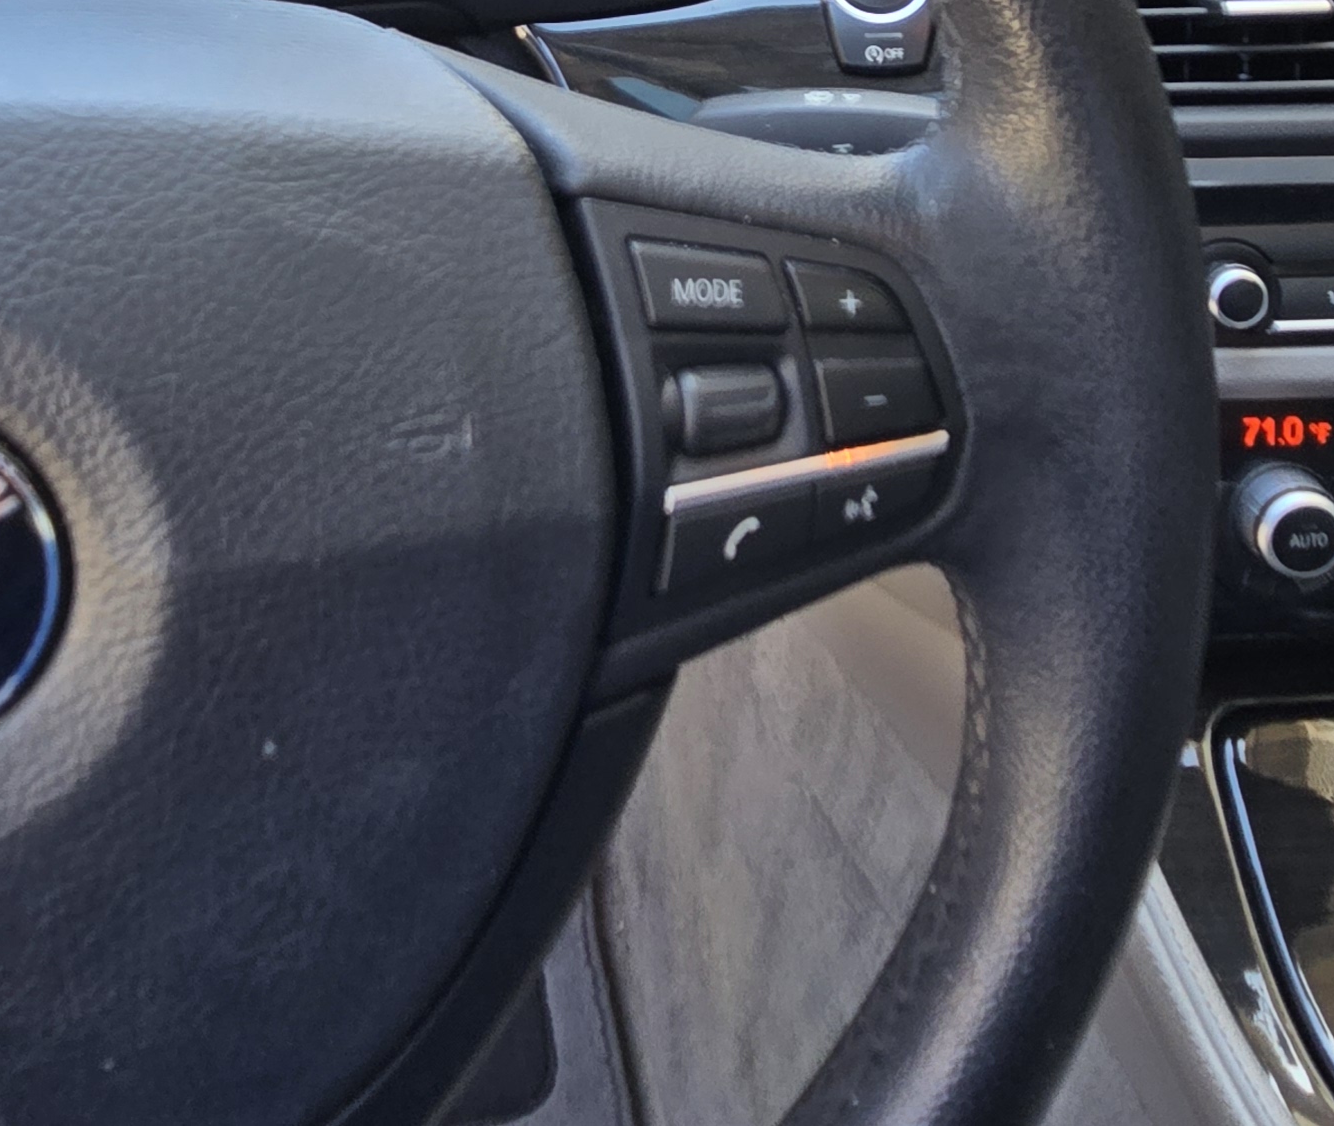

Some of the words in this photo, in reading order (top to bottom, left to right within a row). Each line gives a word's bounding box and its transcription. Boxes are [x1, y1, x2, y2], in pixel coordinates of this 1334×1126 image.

[671, 277, 745, 309] MODE
[1242, 415, 1304, 447] 71.0
[1289, 532, 1328, 548] AUTO
